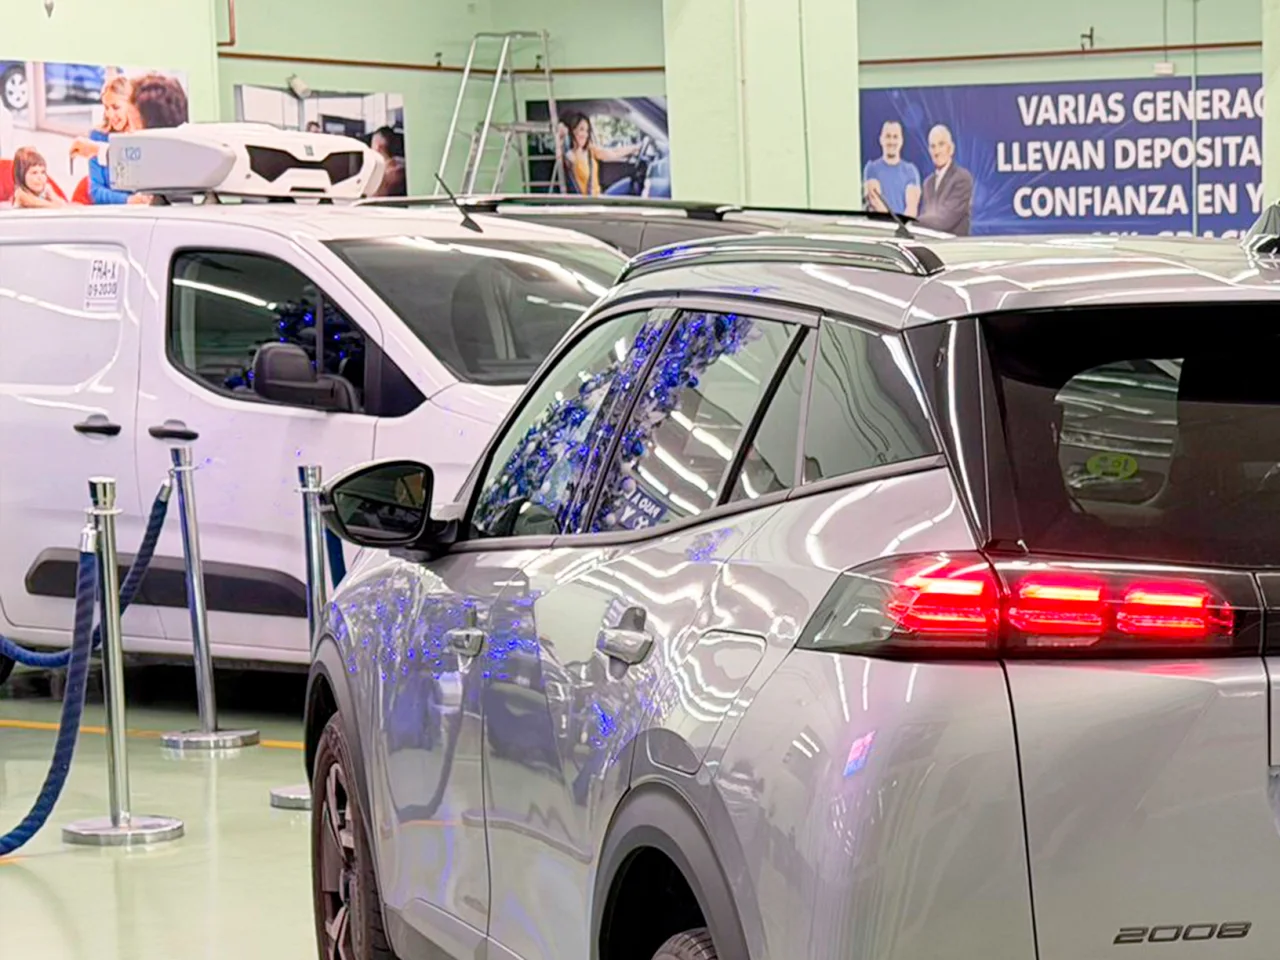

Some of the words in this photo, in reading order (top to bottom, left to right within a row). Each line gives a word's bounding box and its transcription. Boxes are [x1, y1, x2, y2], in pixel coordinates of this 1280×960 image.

[1017, 92, 1126, 126] VARIAS
[997, 139, 1105, 171] LLEVAN
[1114, 135, 1262, 170] DEPOSITA
[1013, 184, 1189, 217] CONFIANZA
[1198, 182, 1238, 214] EN
[1113, 922, 1252, 945] 2008
